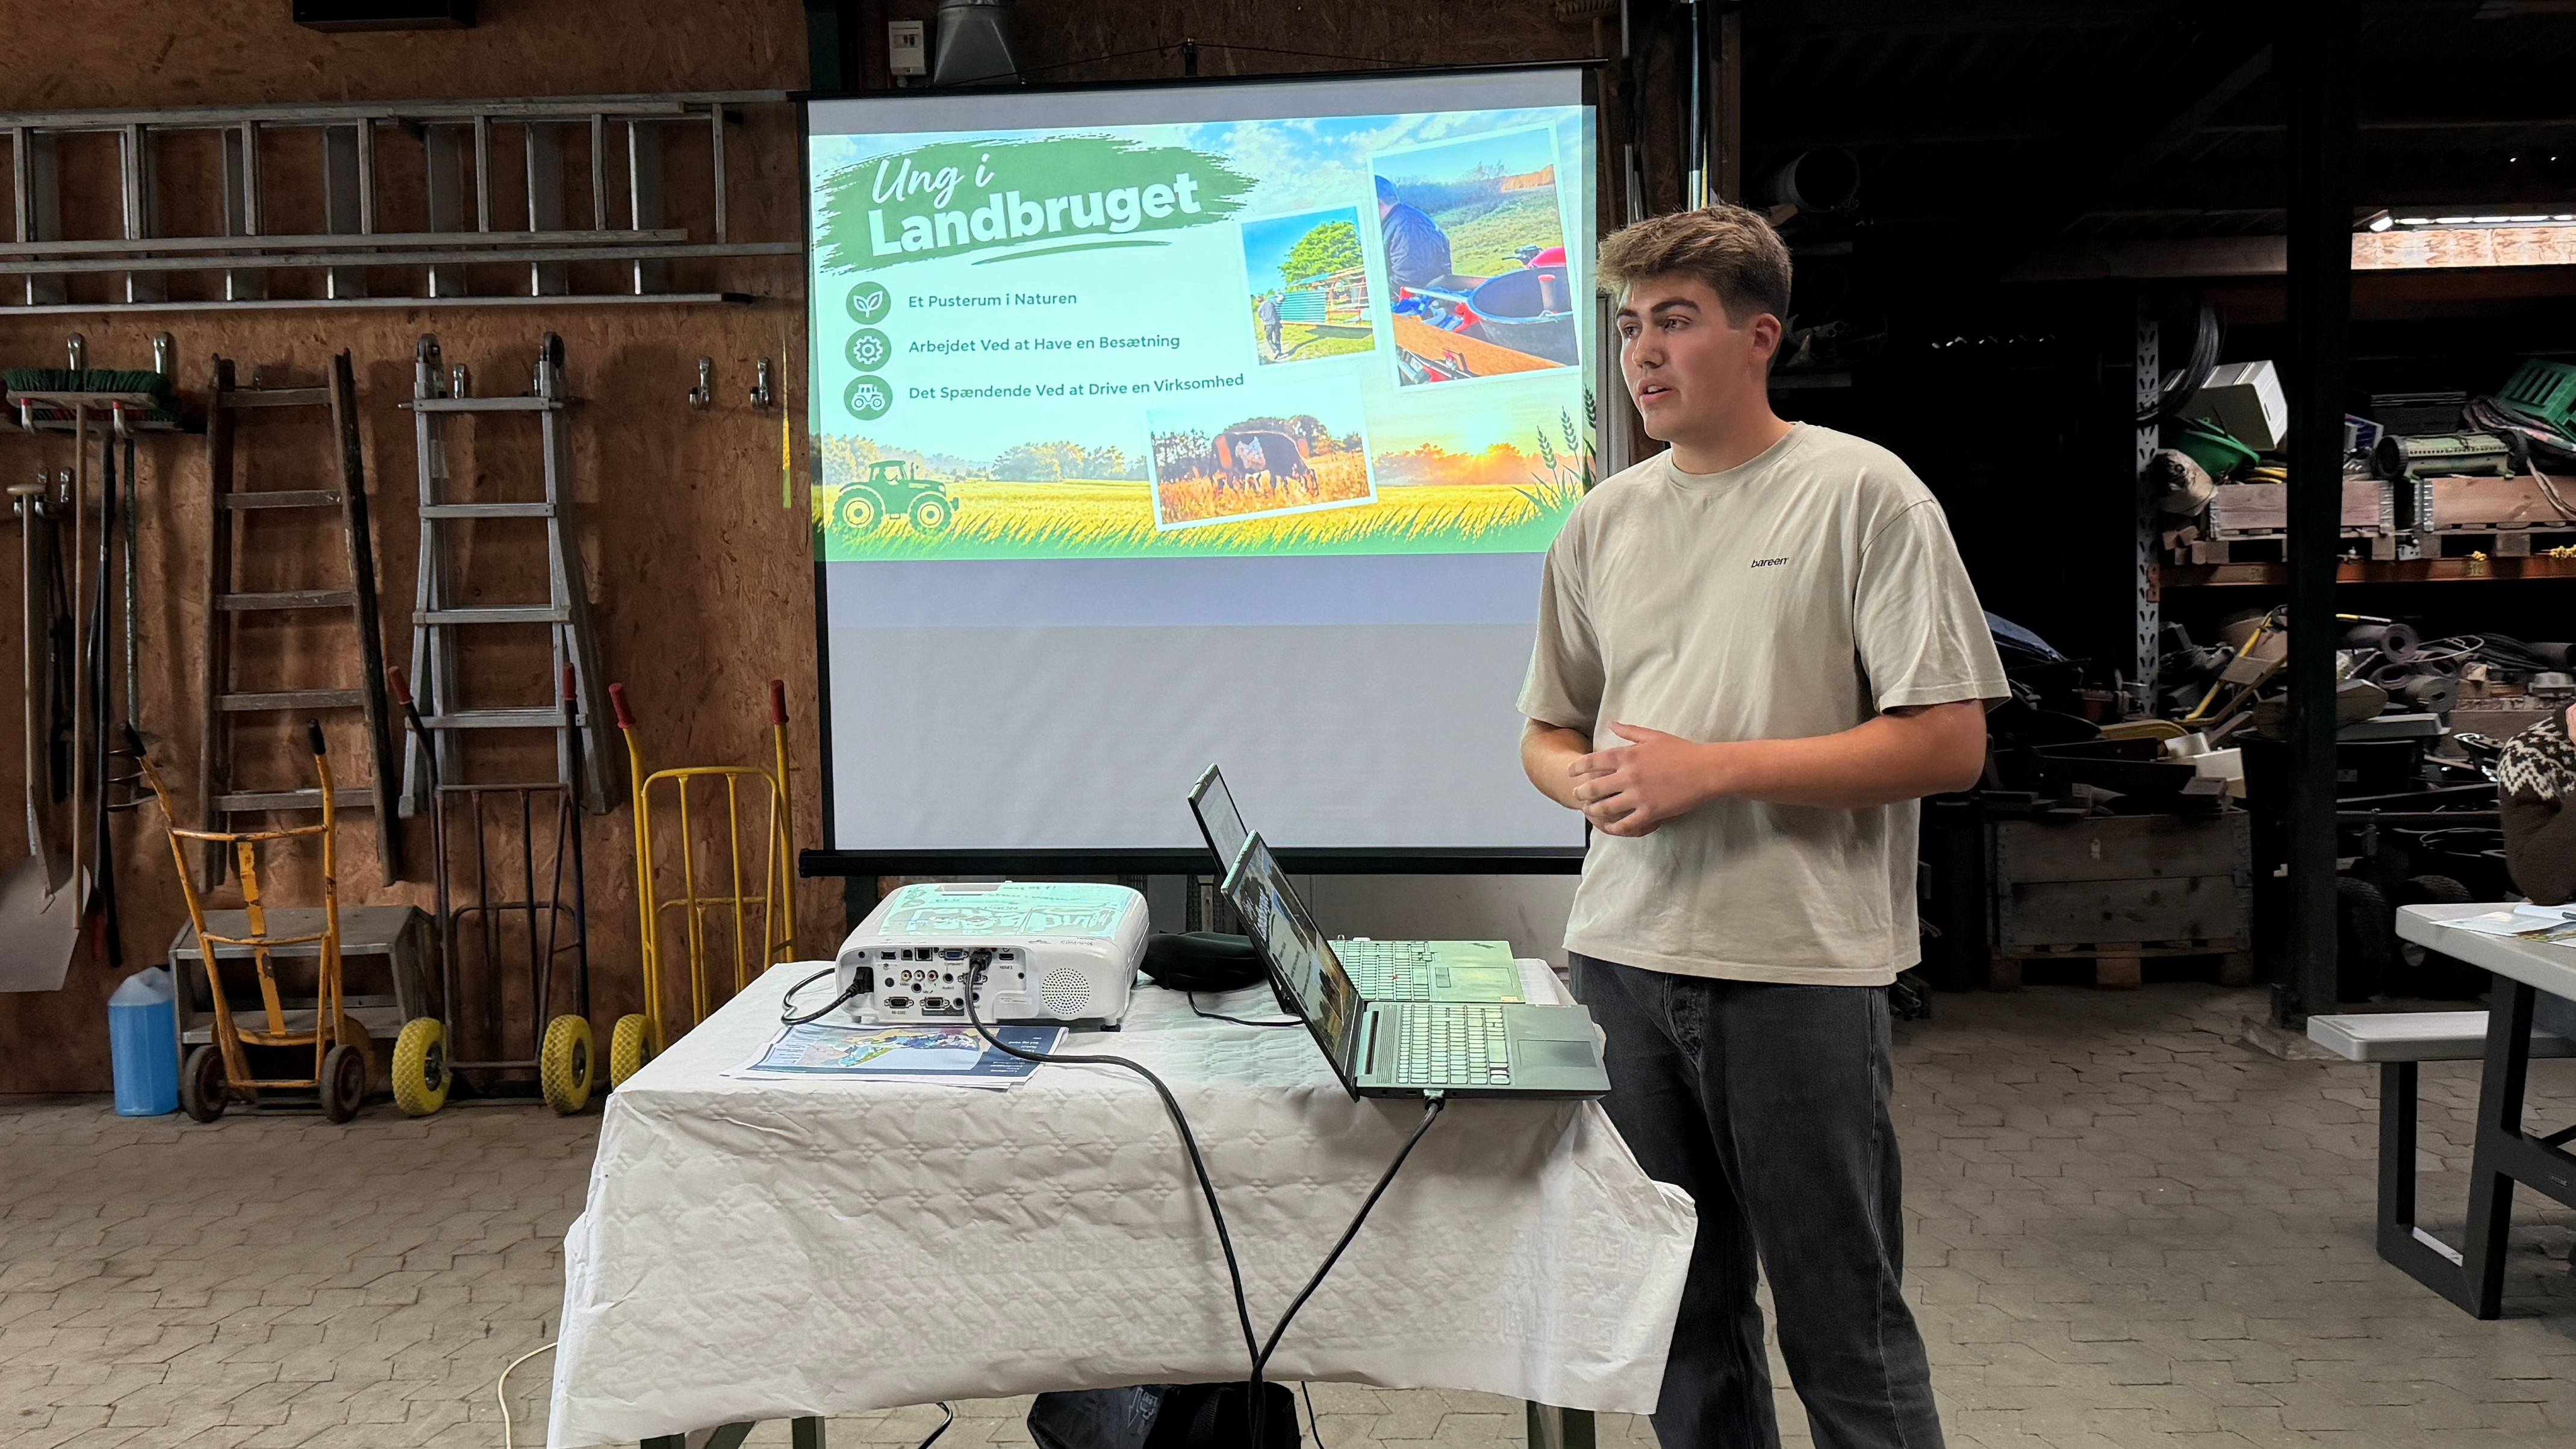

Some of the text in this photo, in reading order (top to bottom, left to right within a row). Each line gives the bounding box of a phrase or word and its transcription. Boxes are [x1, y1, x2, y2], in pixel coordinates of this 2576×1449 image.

[871, 154, 995, 209] Ung i
[868, 172, 1202, 258] Landbruget
[909, 292, 1077, 308] Et Pusterum i Naturen
[909, 334, 1181, 355] Arbejdet Ved at Have en Besætning
[909, 373, 1245, 402] Det Spændende Ved at Drive en Virksomhed
